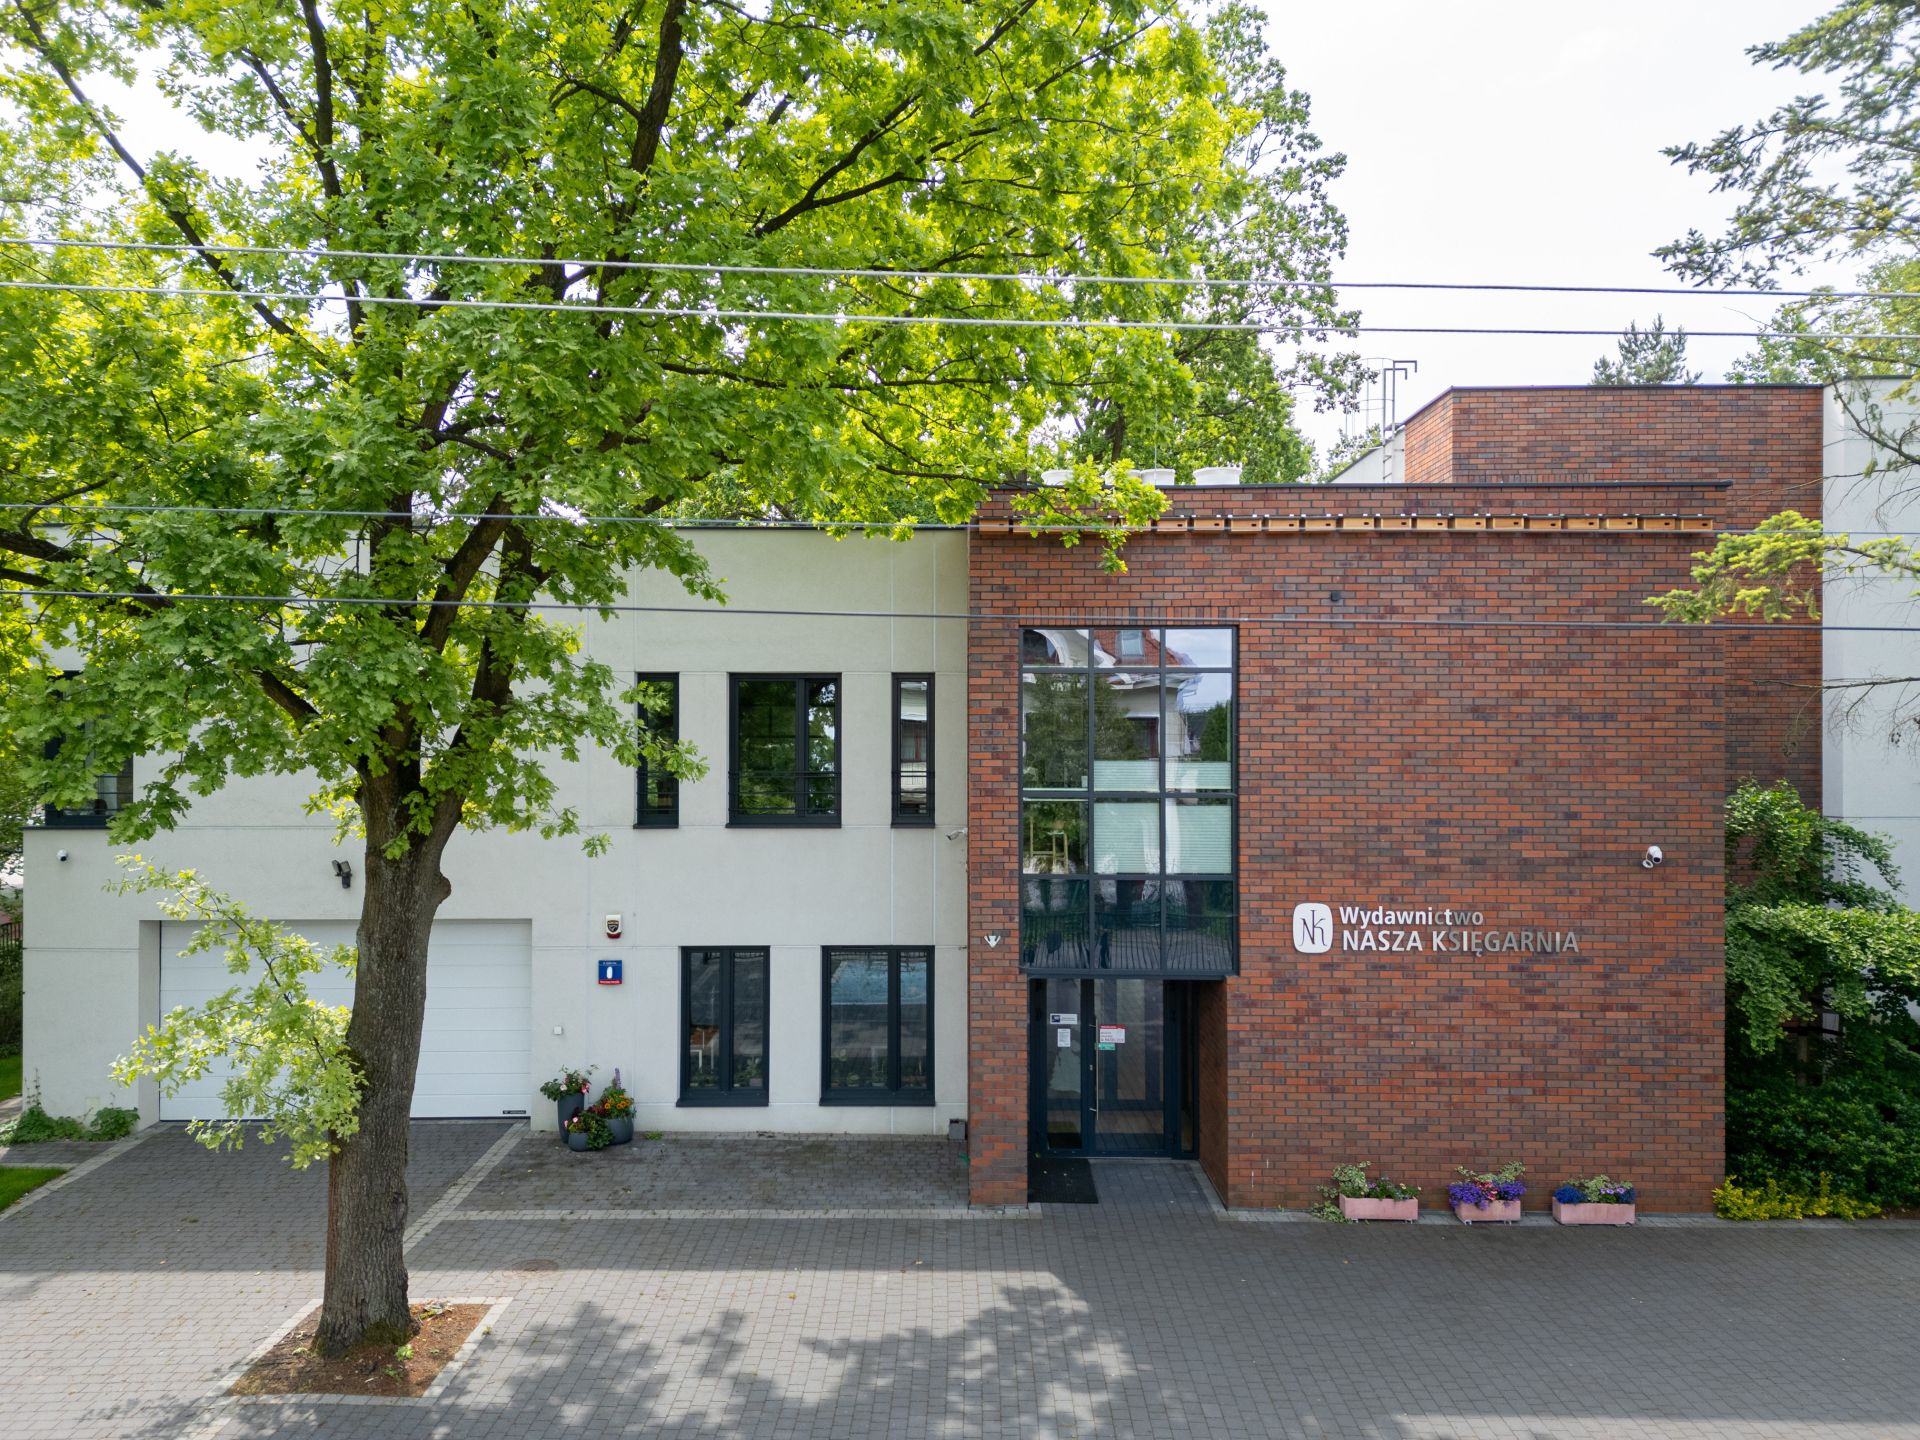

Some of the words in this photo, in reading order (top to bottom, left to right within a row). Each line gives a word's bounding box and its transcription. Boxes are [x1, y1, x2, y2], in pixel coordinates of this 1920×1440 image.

[1340, 906, 1484, 929] Wydawnictwo
[1343, 930, 1423, 952] NASZA
[1432, 930, 1579, 957] KSIĘGARNIA
